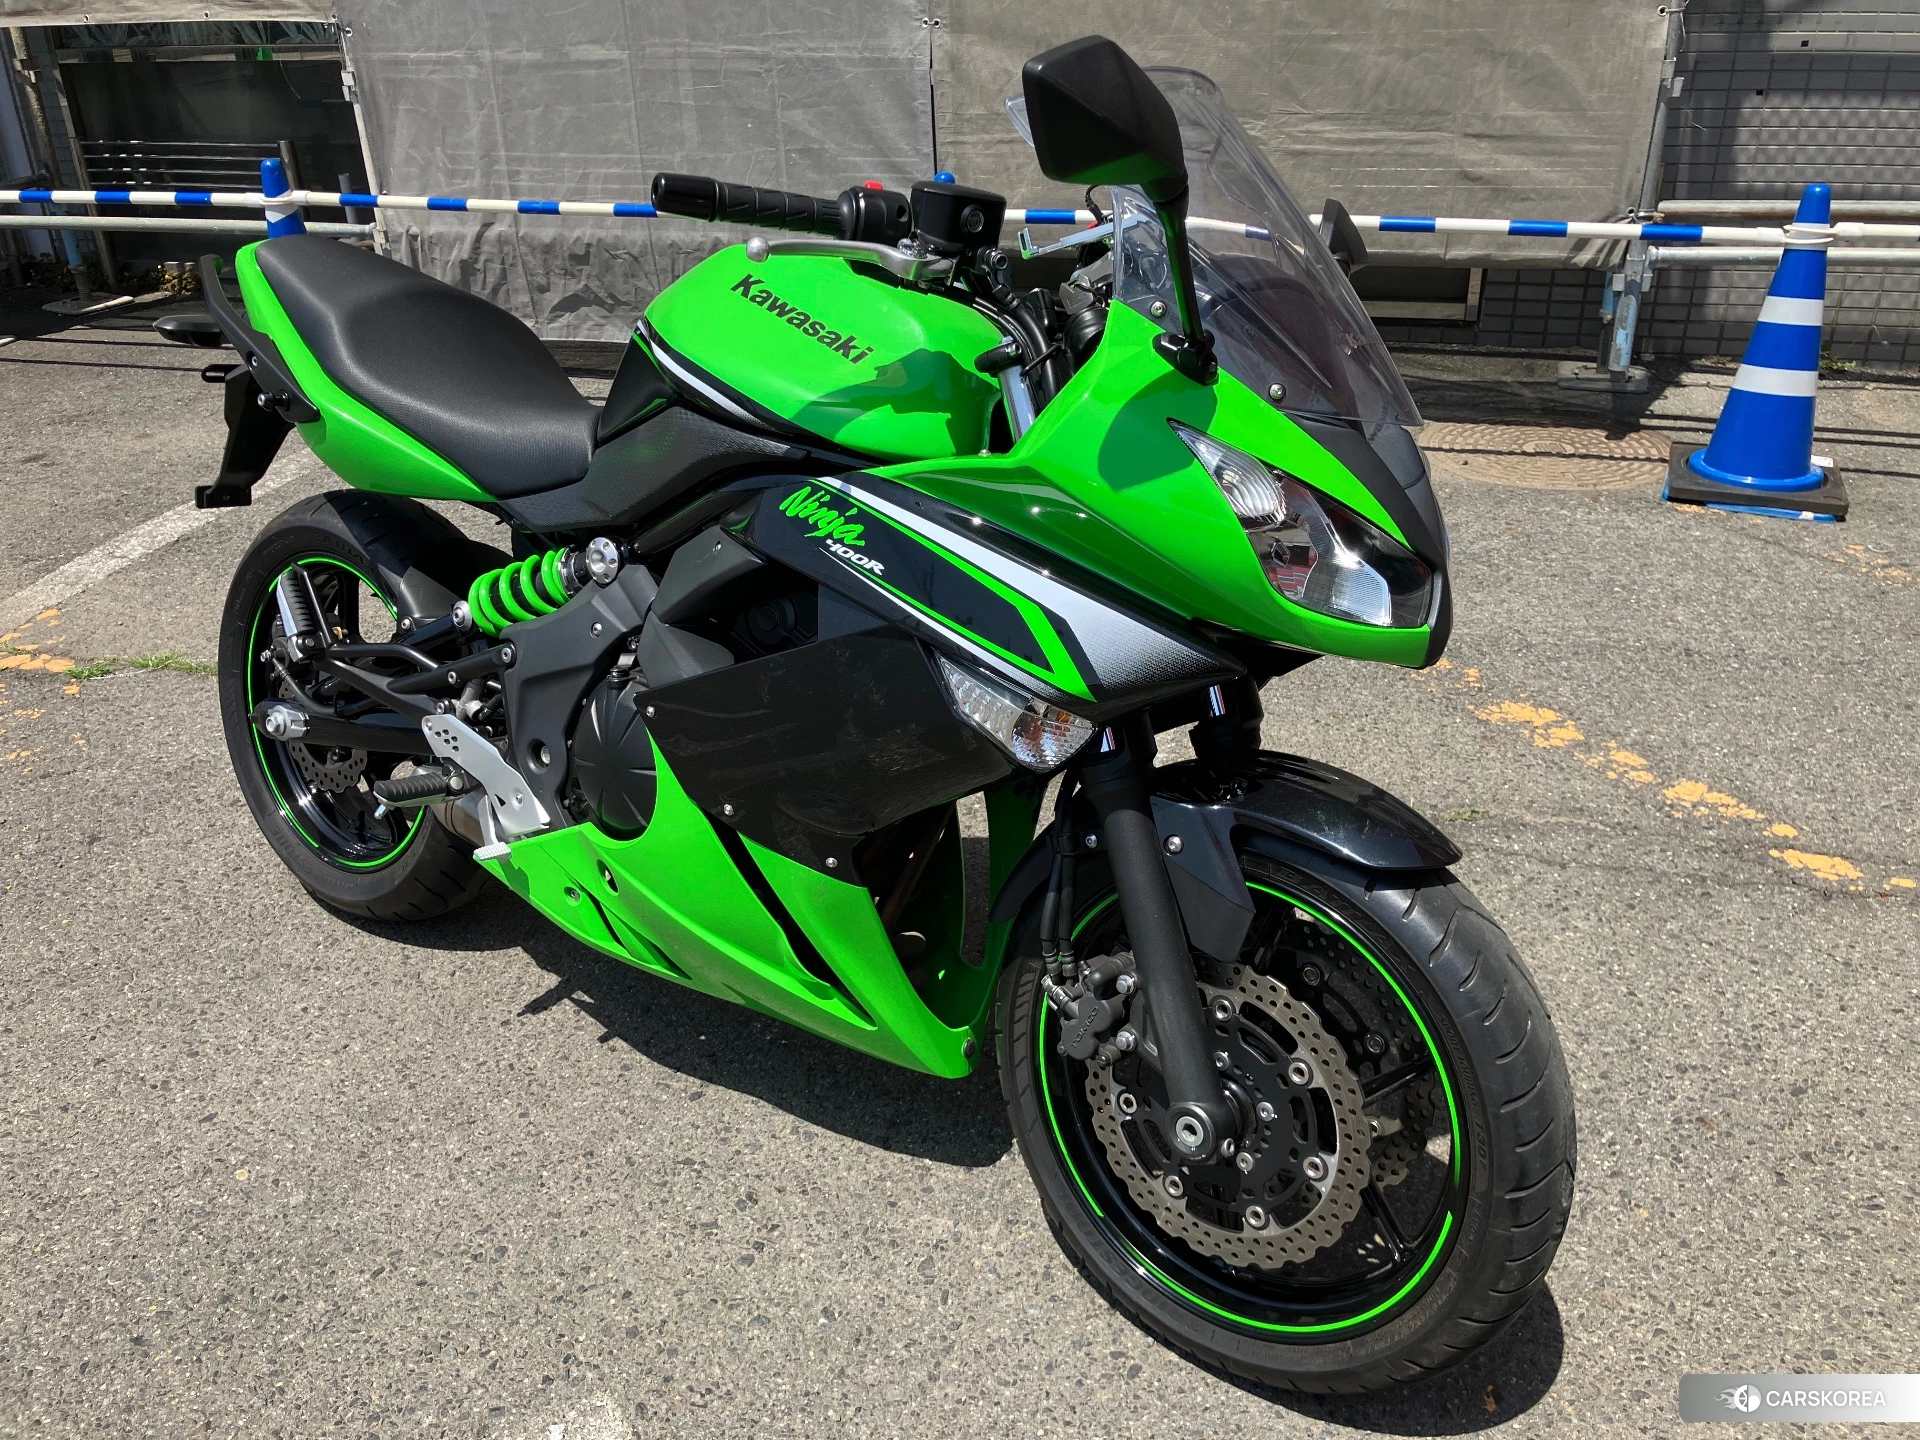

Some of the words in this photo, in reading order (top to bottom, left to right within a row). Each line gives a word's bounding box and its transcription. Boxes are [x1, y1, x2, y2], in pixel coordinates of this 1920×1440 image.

[730, 274, 874, 364] Kawasaki
[779, 486, 865, 547] Ninja
[825, 538, 885, 575] 400R
[1071, 1006, 1099, 1049] TOKICO
